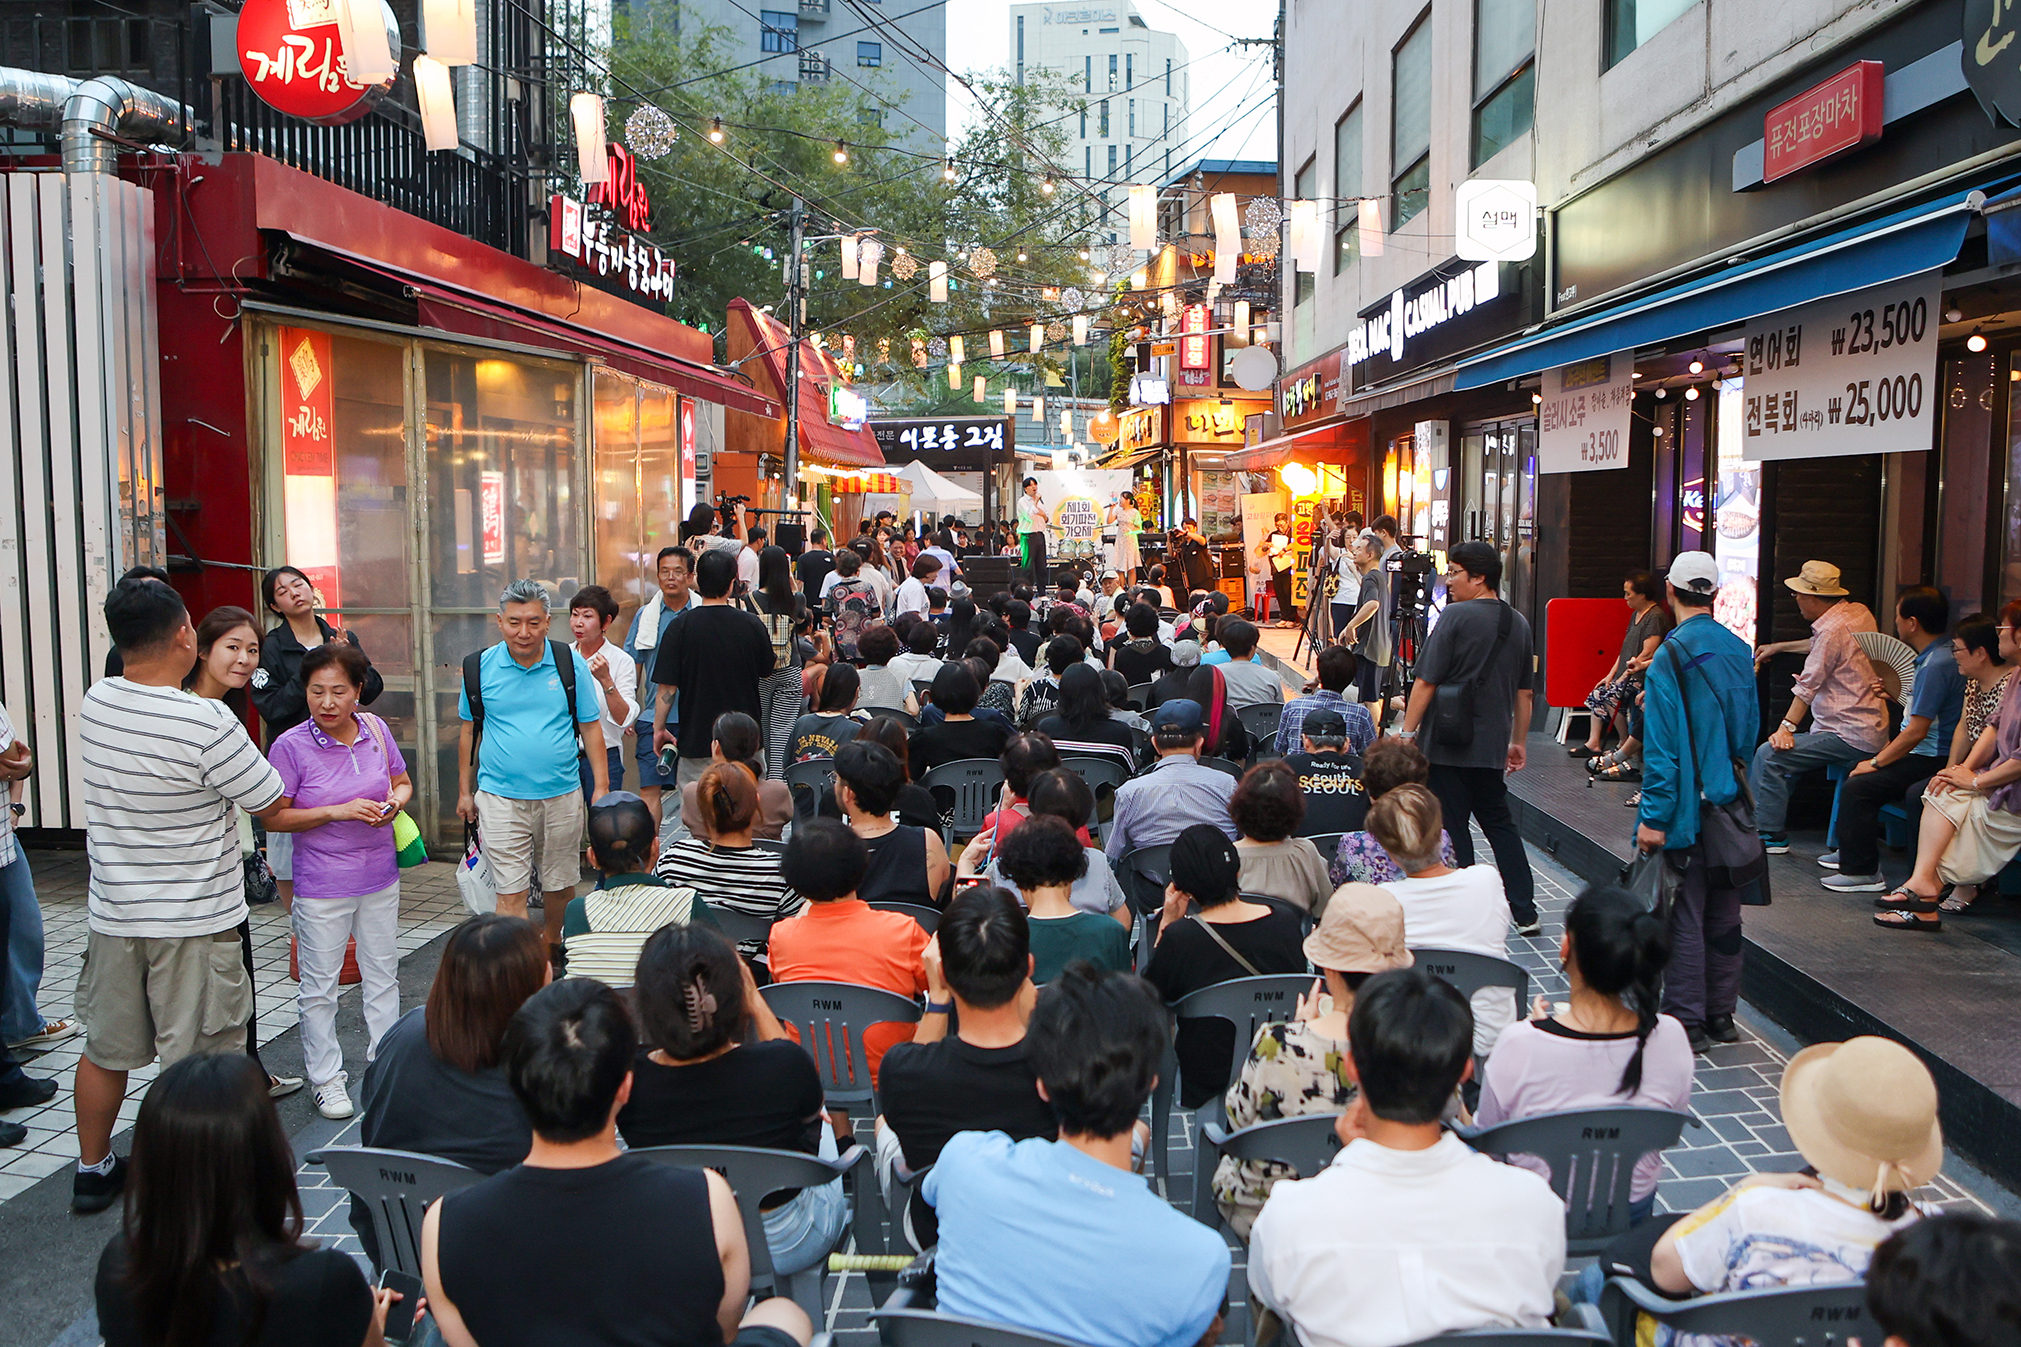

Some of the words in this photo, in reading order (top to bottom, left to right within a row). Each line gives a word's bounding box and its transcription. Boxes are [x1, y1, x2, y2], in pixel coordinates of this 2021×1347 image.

[1769, 83, 1858, 160] 퓨전포장마차
[1482, 211, 1517, 229] 설맥
[1368, 310, 1391, 357] MAC
[1404, 283, 1448, 339] CASUAL
[1447, 269, 1475, 320] PUB
[1187, 308, 1204, 366] 단체환영
[1749, 324, 1802, 376] 연어회
[1746, 389, 1798, 438] 전복회
[1799, 409, 1824, 431] (4마리)
[288, 405, 327, 441] 계림원
[873, 430, 895, 442] 전문
[899, 424, 960, 451] 이문동
[1066, 501, 1091, 513] 제1회
[1297, 502, 1314, 517] 고향
[1061, 513, 1096, 525] 회기파전
[1065, 525, 1092, 537] 가요제
[966, 769, 984, 777] RWM
[1298, 775, 1364, 792] SCOUTS
[1426, 964, 1456, 976] RWM
[1254, 991, 1285, 1002] RWM
[812, 999, 842, 1011] RWM
[1582, 1126, 1621, 1141] RWM
[379, 1168, 417, 1186] RWM
[1810, 1306, 1861, 1322] RWM
